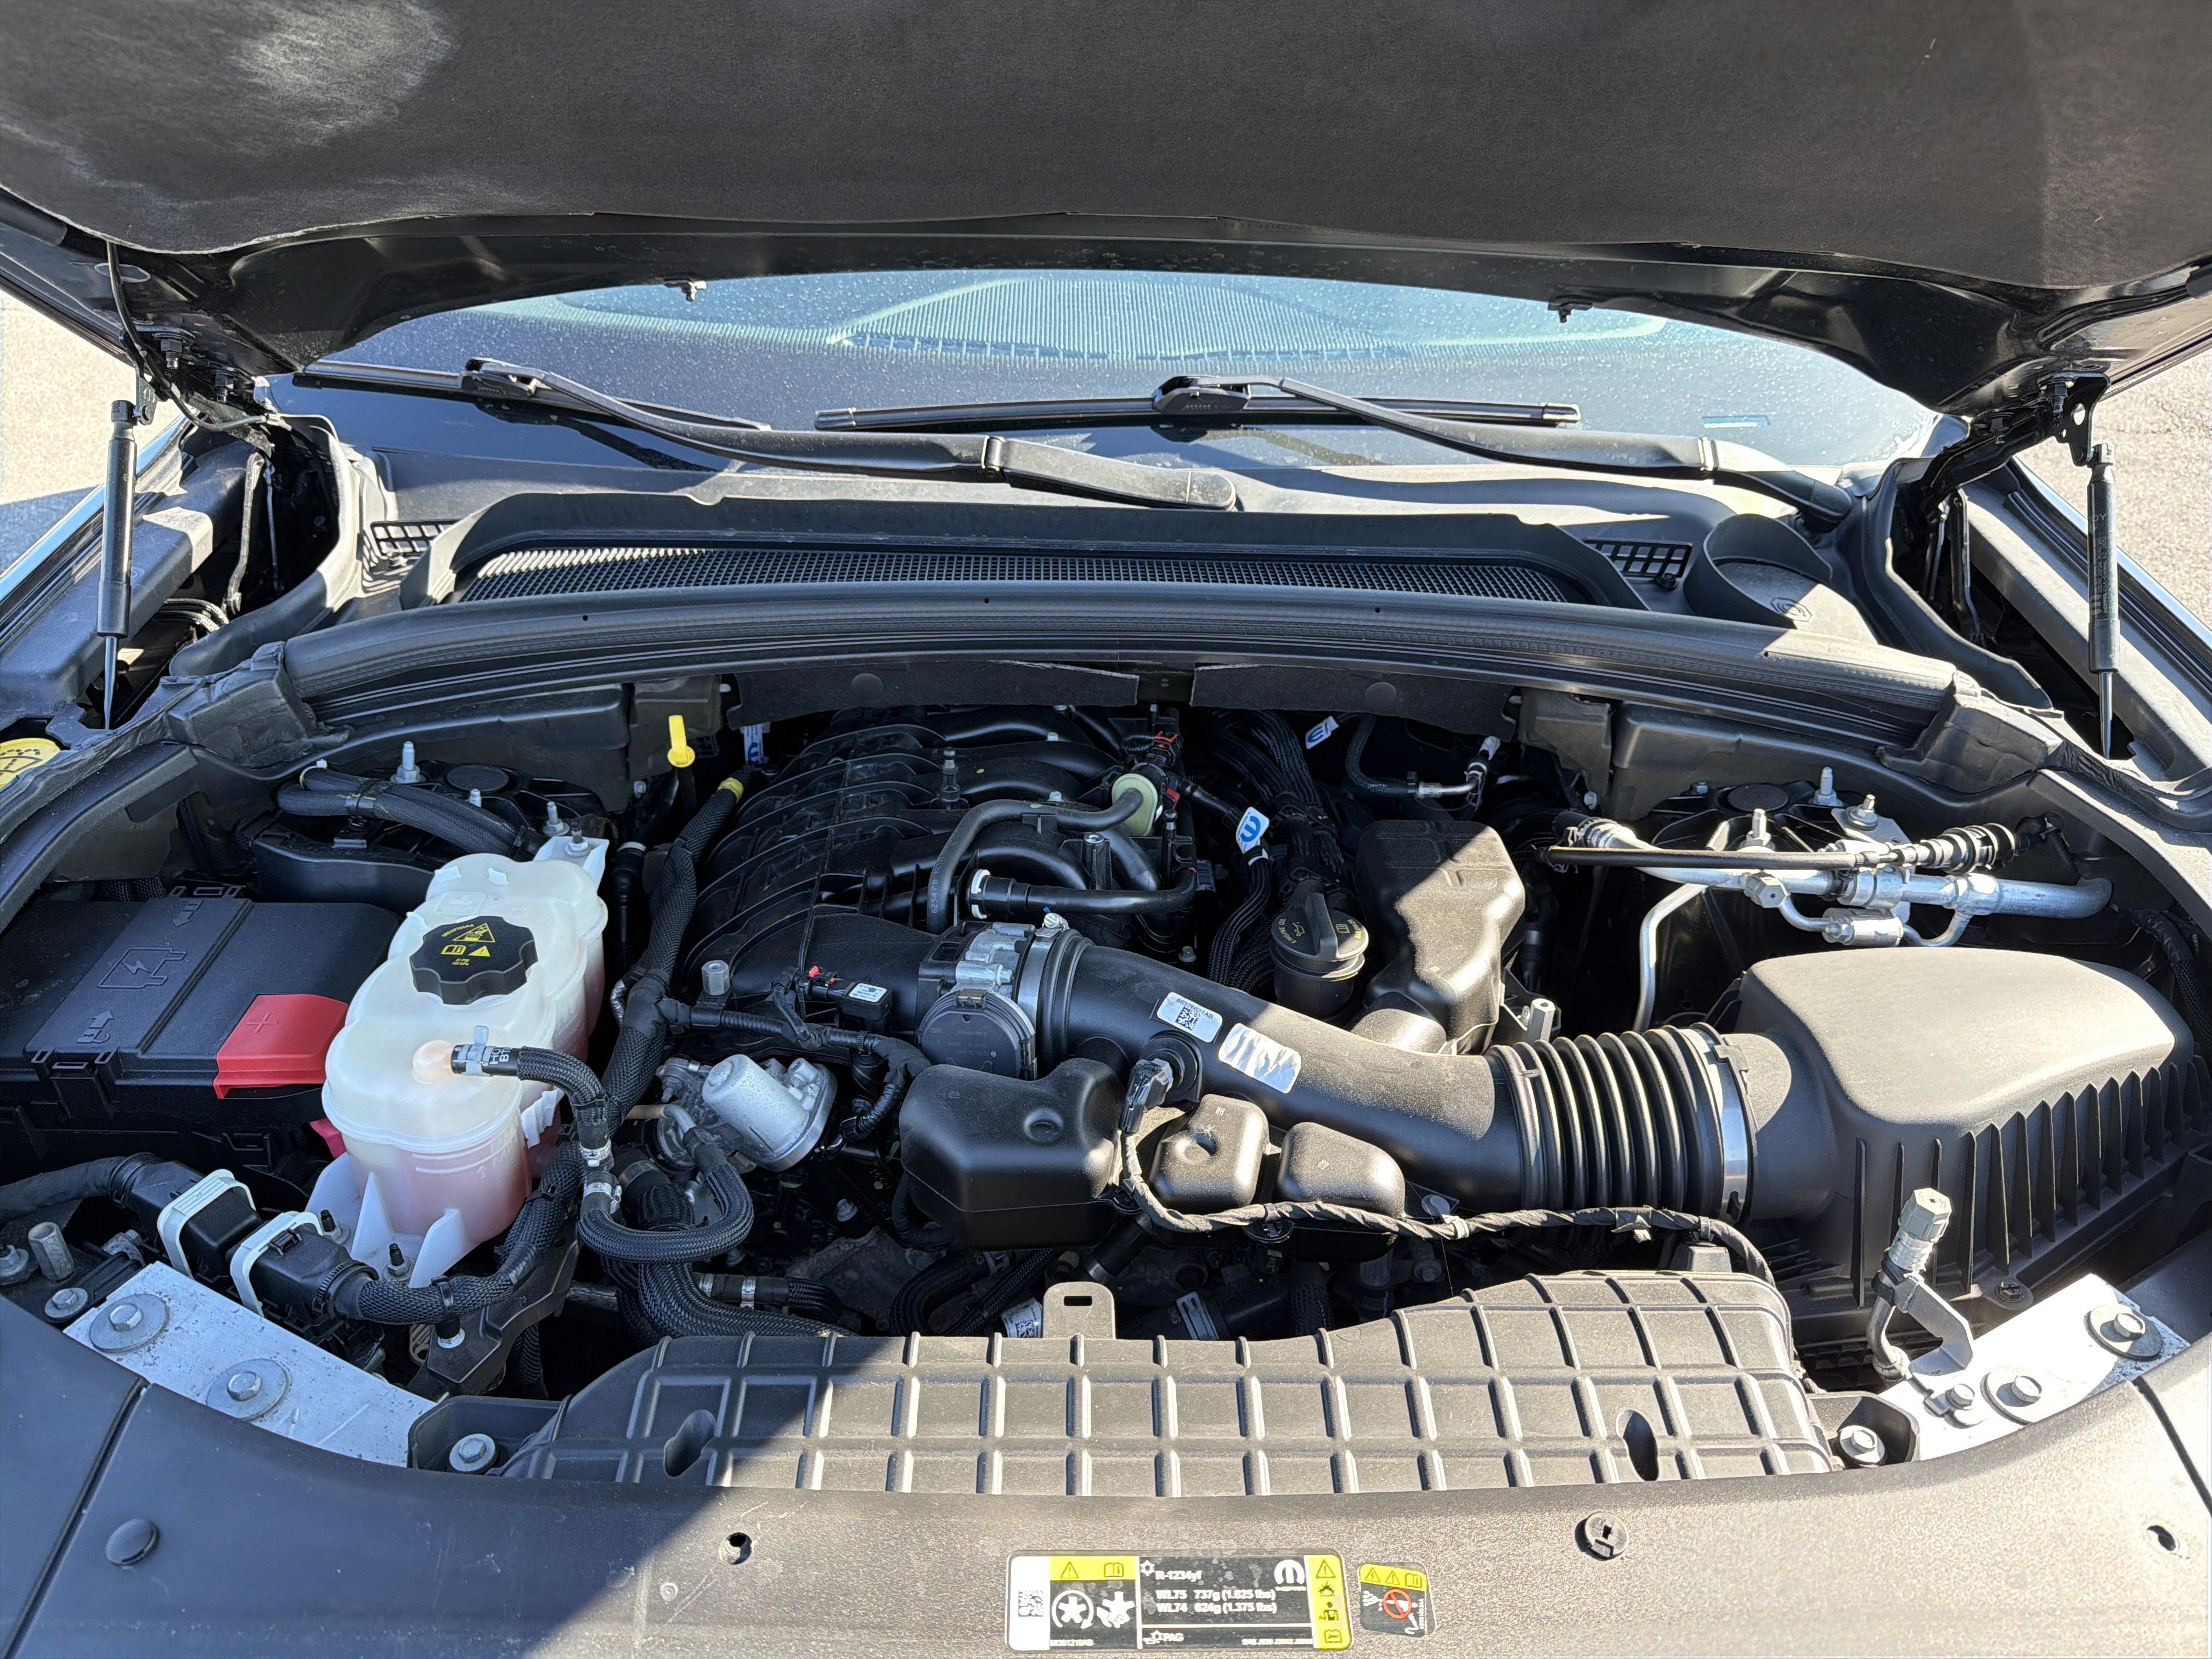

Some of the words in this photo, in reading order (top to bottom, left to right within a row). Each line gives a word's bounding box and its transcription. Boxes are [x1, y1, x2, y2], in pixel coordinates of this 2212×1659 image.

[1278, 927, 1297, 944] ENGINE
[1167, 1307, 1181, 1324] ENG
[1155, 1570, 1203, 1582] R-1234yf
[1155, 1589, 1188, 1600] WL75
[1193, 1589, 1221, 1601] 737g
[1222, 1589, 1254, 1601] (1.625
[1255, 1589, 1276, 1601] lbs)
[1156, 1602, 1188, 1612] WL74
[1194, 1602, 1221, 1615] 624g
[1222, 1602, 1255, 1614] (1.375
[1256, 1602, 1277, 1614] lbs)
[1163, 1633, 1184, 1642] PAG
